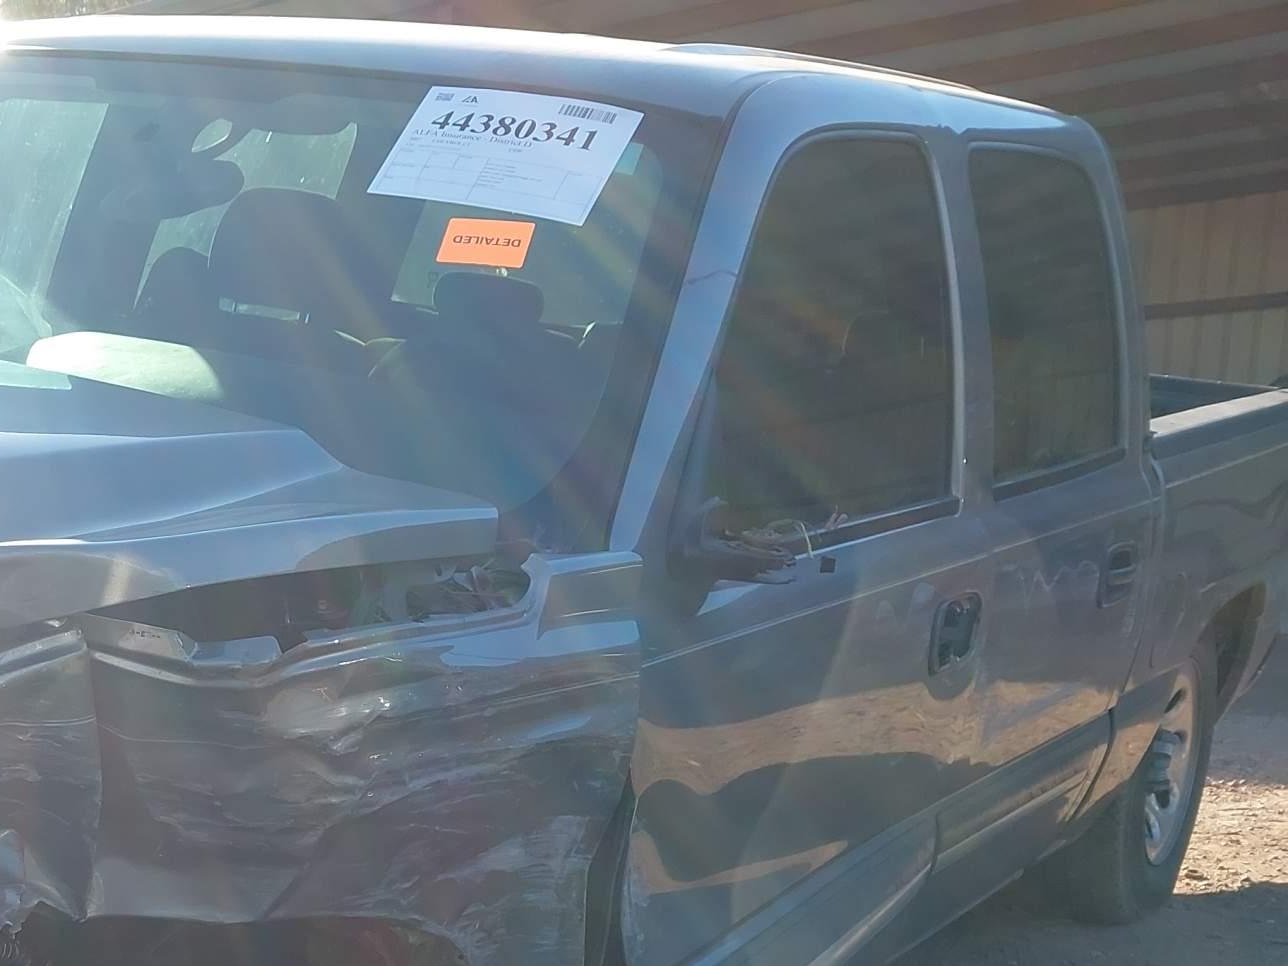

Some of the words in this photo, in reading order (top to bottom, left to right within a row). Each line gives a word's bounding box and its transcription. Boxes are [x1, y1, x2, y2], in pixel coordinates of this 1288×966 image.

[431, 110, 600, 151] 44380341
[441, 131, 482, 142] Insurance
[452, 234, 522, 248] DETAILED
